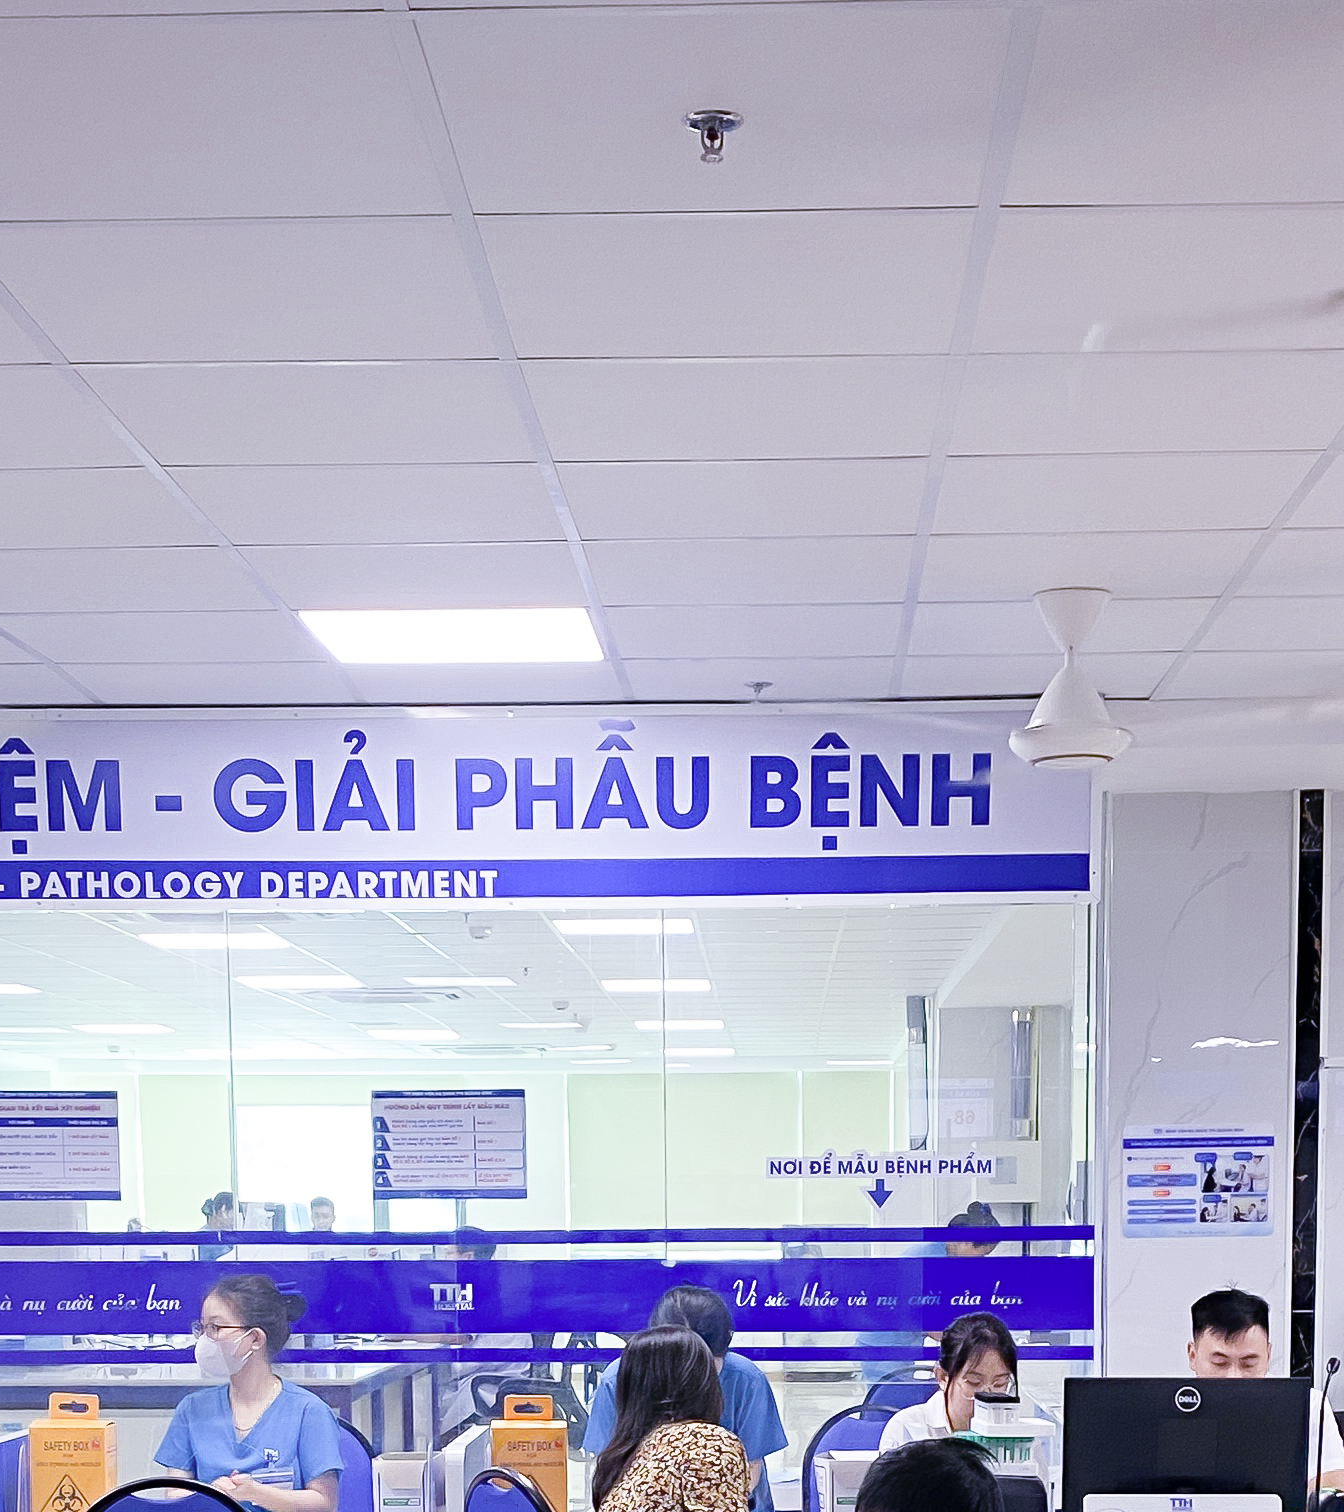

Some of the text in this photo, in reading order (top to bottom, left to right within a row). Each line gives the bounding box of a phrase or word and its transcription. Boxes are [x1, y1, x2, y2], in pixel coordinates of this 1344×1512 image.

[154, 795, 183, 812] -
[213, 729, 416, 833] GIẢI
[455, 718, 710, 831] PHẪU
[749, 731, 993, 851] BỆNH
[19, 870, 244, 899] PATHOLOGY
[259, 869, 499, 899] DEPARTMENT
[769, 1151, 993, 1178] NƠI ĐỂ MẪU BỆNH PHẨM
[22, 1299, 47, 1316] nụ
[56, 1294, 95, 1312] cười
[145, 1283, 183, 1316] bạn
[799, 1282, 840, 1308] khỏe
[847, 1289, 869, 1307] và
[950, 1289, 982, 1307] của
[43, 1440, 90, 1452] SAFETY BOX
[507, 1440, 553, 1452] SAFETY BOX
